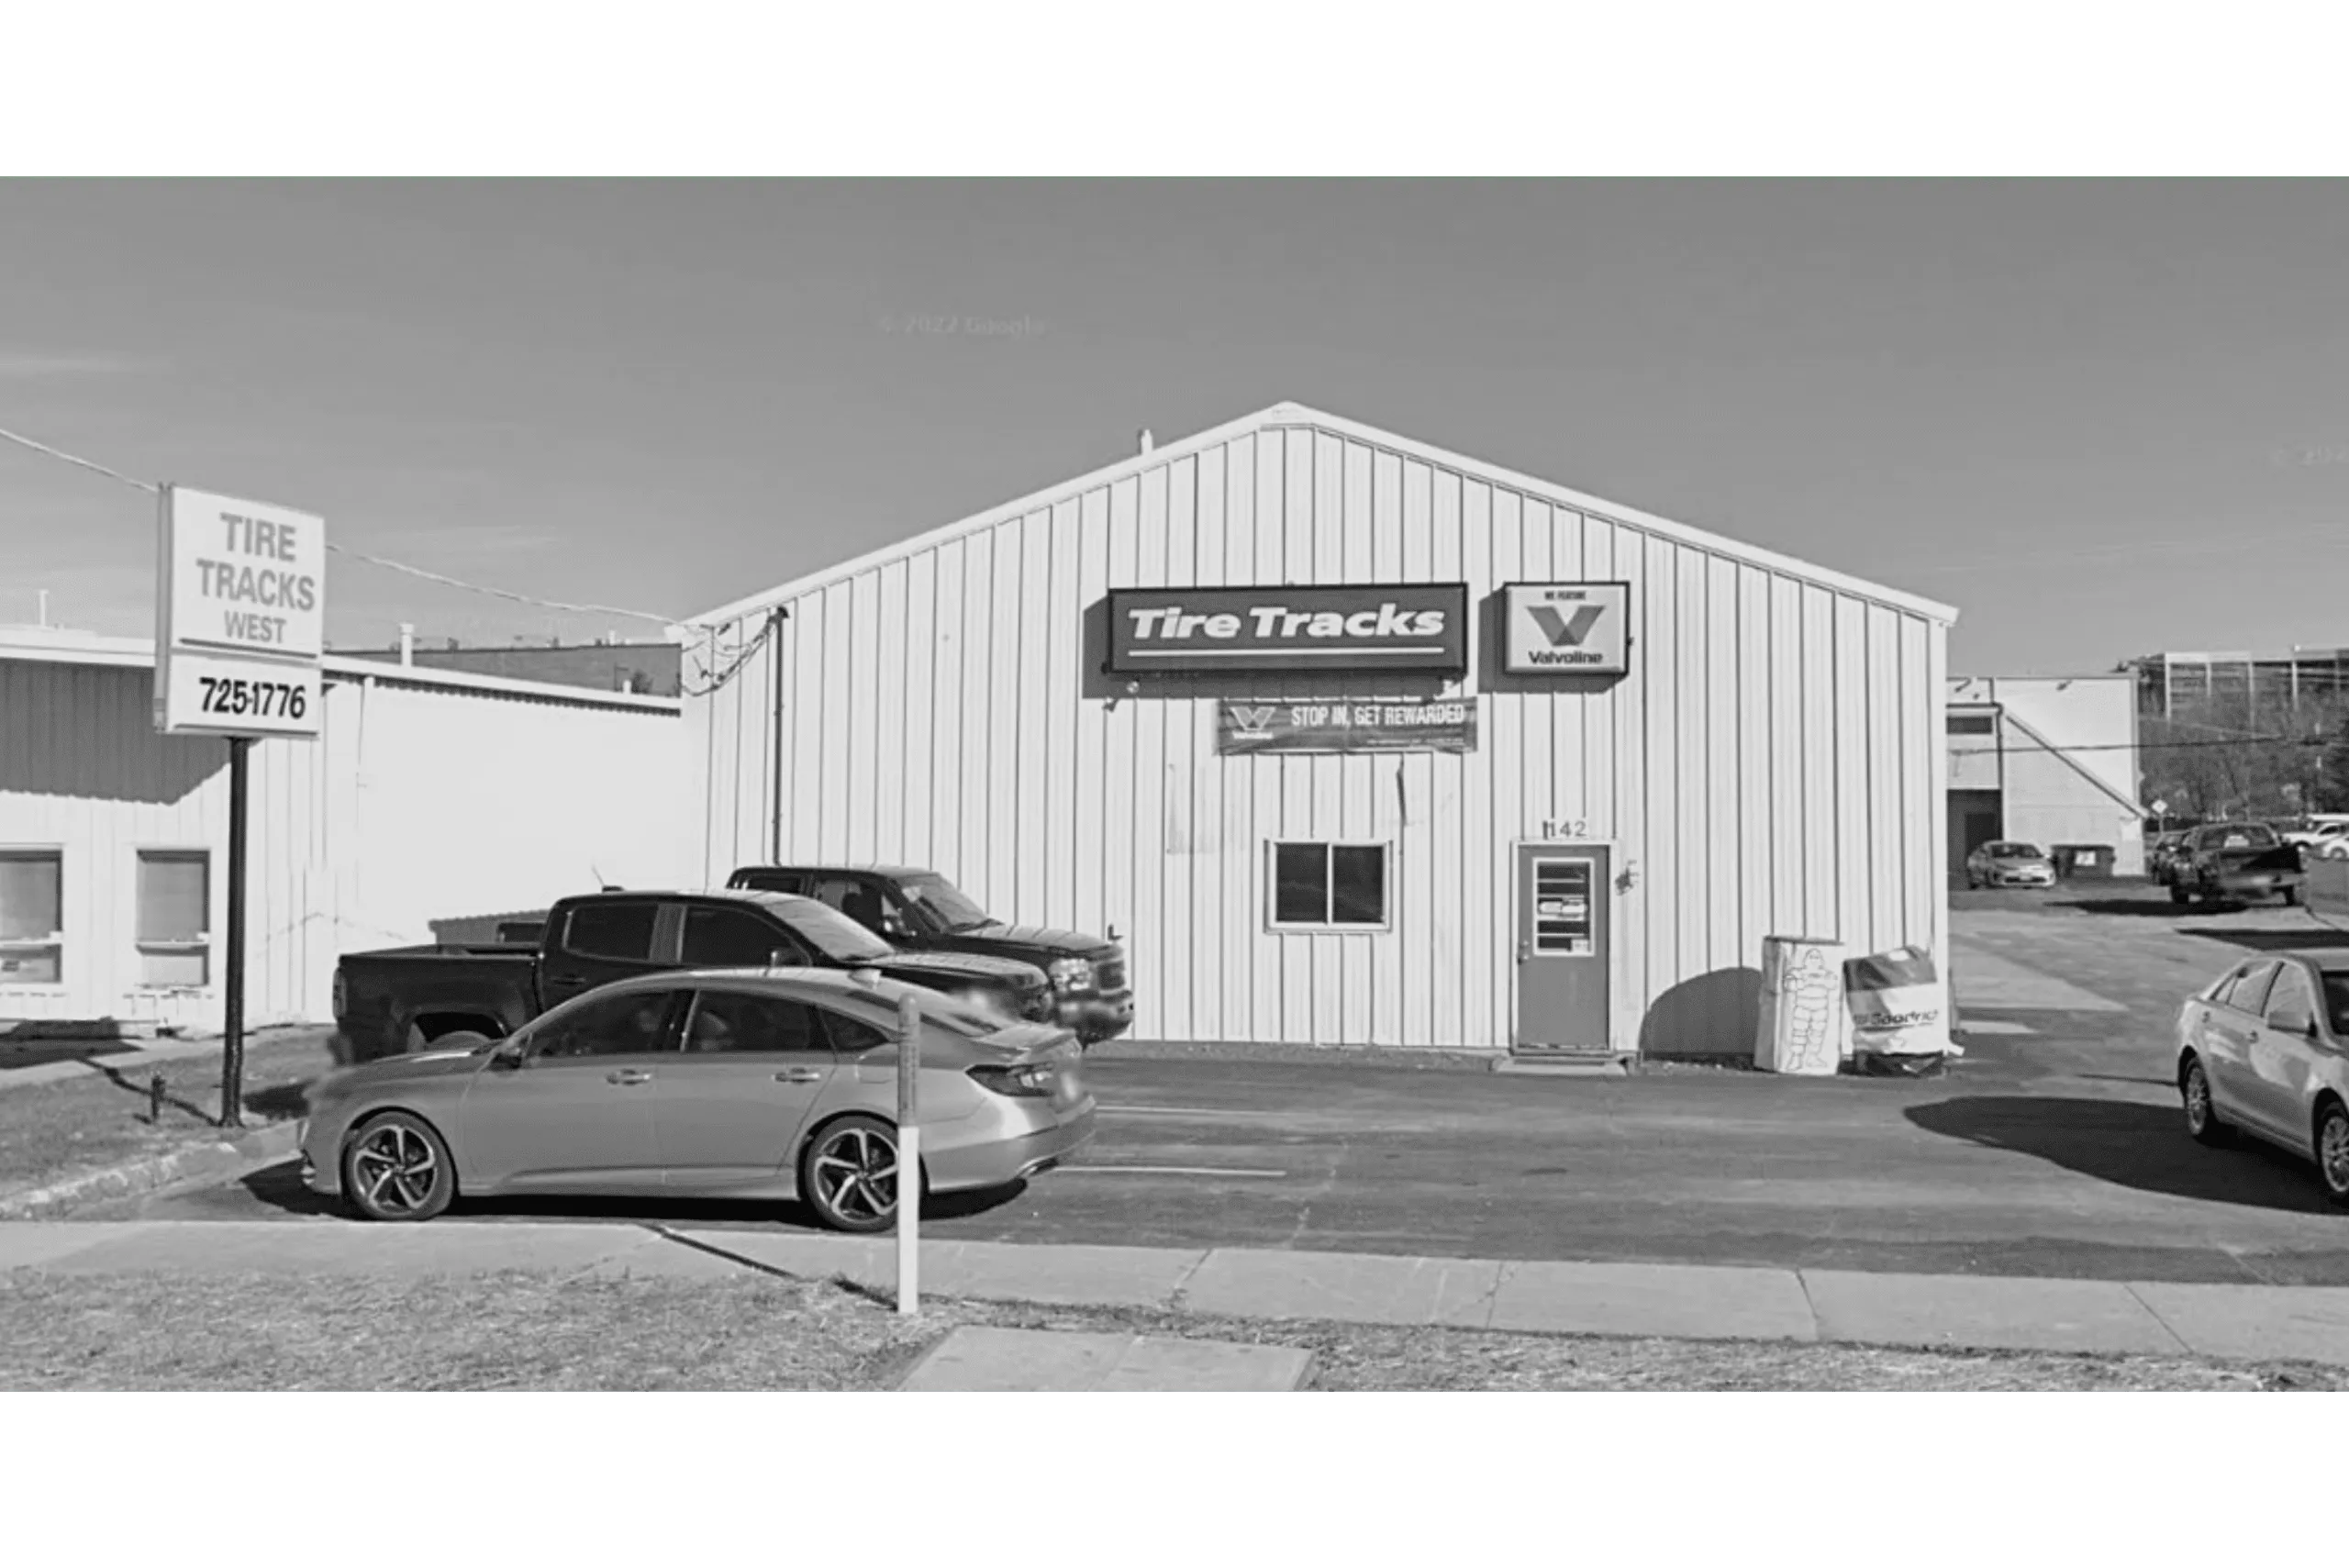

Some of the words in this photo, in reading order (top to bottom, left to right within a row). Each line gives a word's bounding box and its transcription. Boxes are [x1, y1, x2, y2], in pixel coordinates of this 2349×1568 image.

[219, 512, 296, 562] TIRE
[195, 558, 315, 611] TRACKS
[224, 610, 287, 643] WEST
[1128, 606, 1241, 639] Tire
[1249, 602, 1445, 639] Tracks
[1528, 651, 1603, 665] Valvoline
[1291, 706, 1329, 727] STOP
[1354, 706, 1382, 726] GET
[1385, 704, 1465, 726] REWARDED
